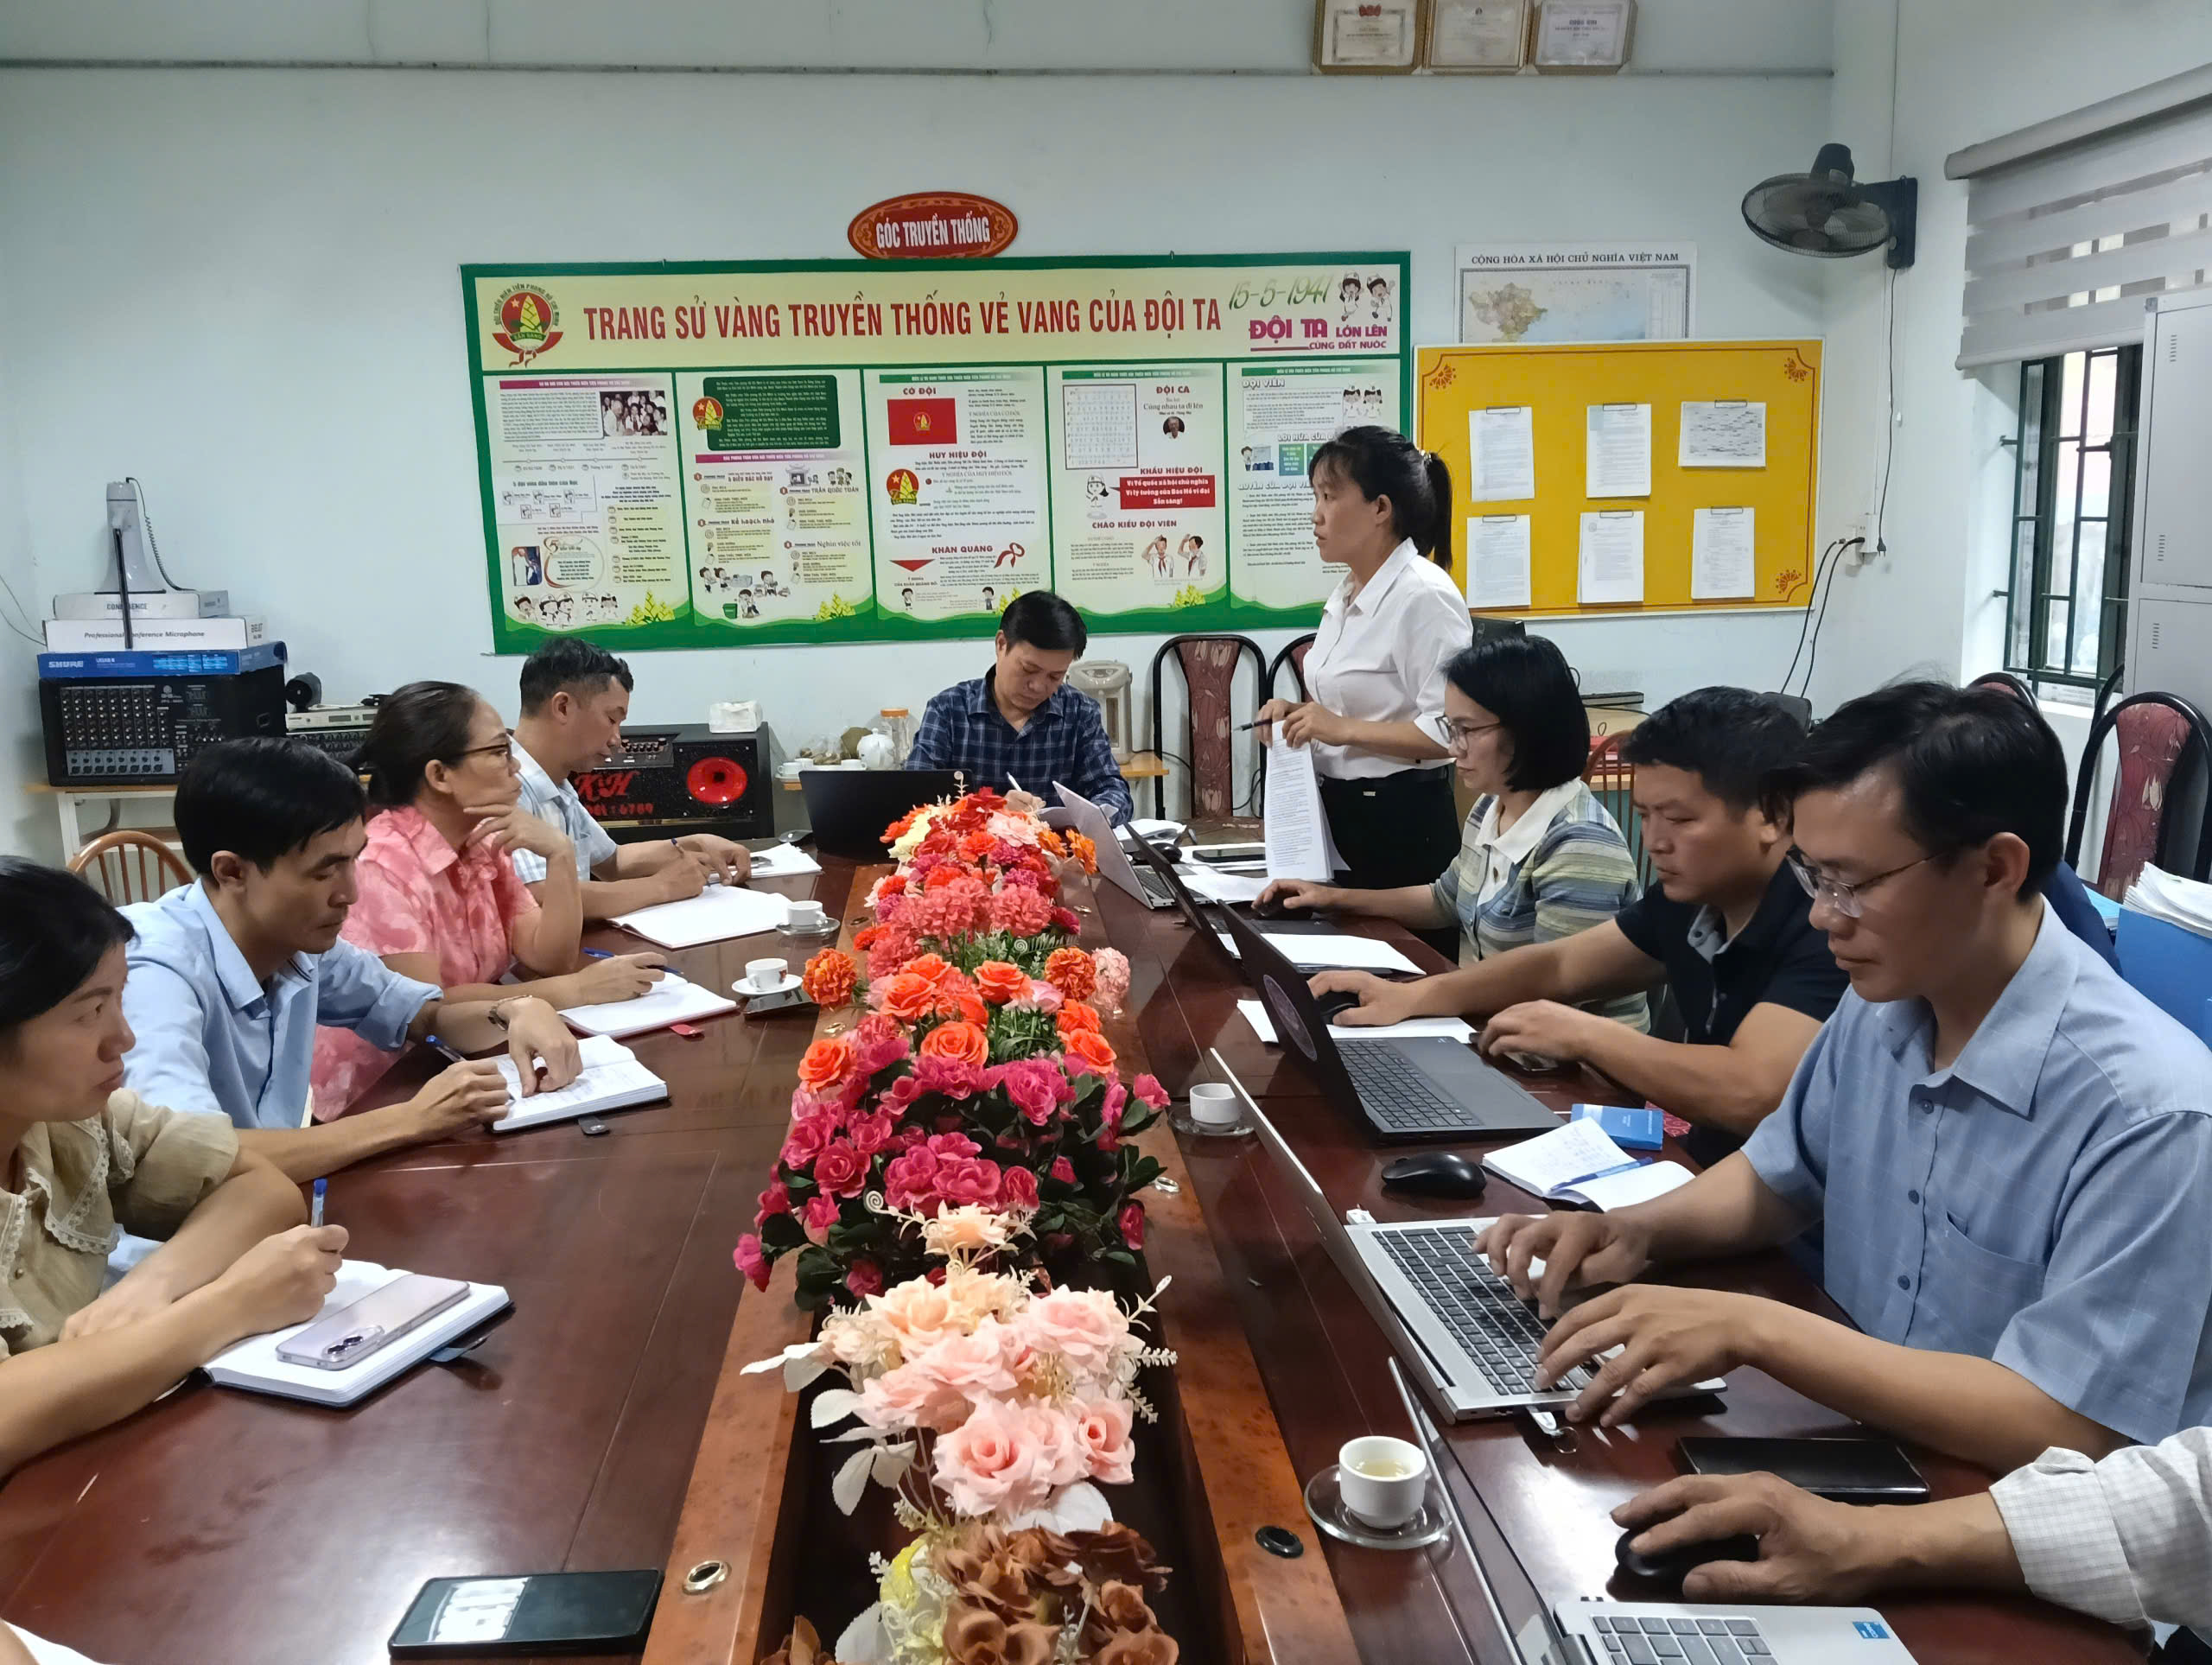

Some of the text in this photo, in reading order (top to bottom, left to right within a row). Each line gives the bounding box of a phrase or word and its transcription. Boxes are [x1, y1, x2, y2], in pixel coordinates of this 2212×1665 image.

[876, 211, 990, 249] GÓC TRUYỀN THỐNG
[1471, 256, 1500, 265] CỘNG
[1547, 253, 1565, 264] HỘI
[1567, 251, 1589, 263] CHỦ
[1592, 252, 1624, 263] NGHĨA
[1629, 252, 1652, 264] VIỆT
[1655, 253, 1679, 262] NAM
[1229, 274, 1333, 310] 15-5-1941
[583, 289, 1222, 340] TRANG SỬ VÀNG TRUYỀN THỐNG VẺ VANG CỦA ĐỘI TA
[1249, 315, 1328, 344] ĐỘI TA
[1336, 324, 1388, 338] LỚN LÊN
[1156, 384, 1174, 395] ĐỘI
[1243, 378, 1261, 390] ĐỘI
[918, 385, 937, 397] ĐỘI
[949, 450, 969, 459] HIỆU
[971, 449, 987, 459] ĐỘI
[1187, 466, 1203, 474] ĐỘI
[1140, 519, 1155, 530] ĐỘI
[1157, 519, 1177, 528] VIÊN
[48, 660, 84, 669] SHURE
